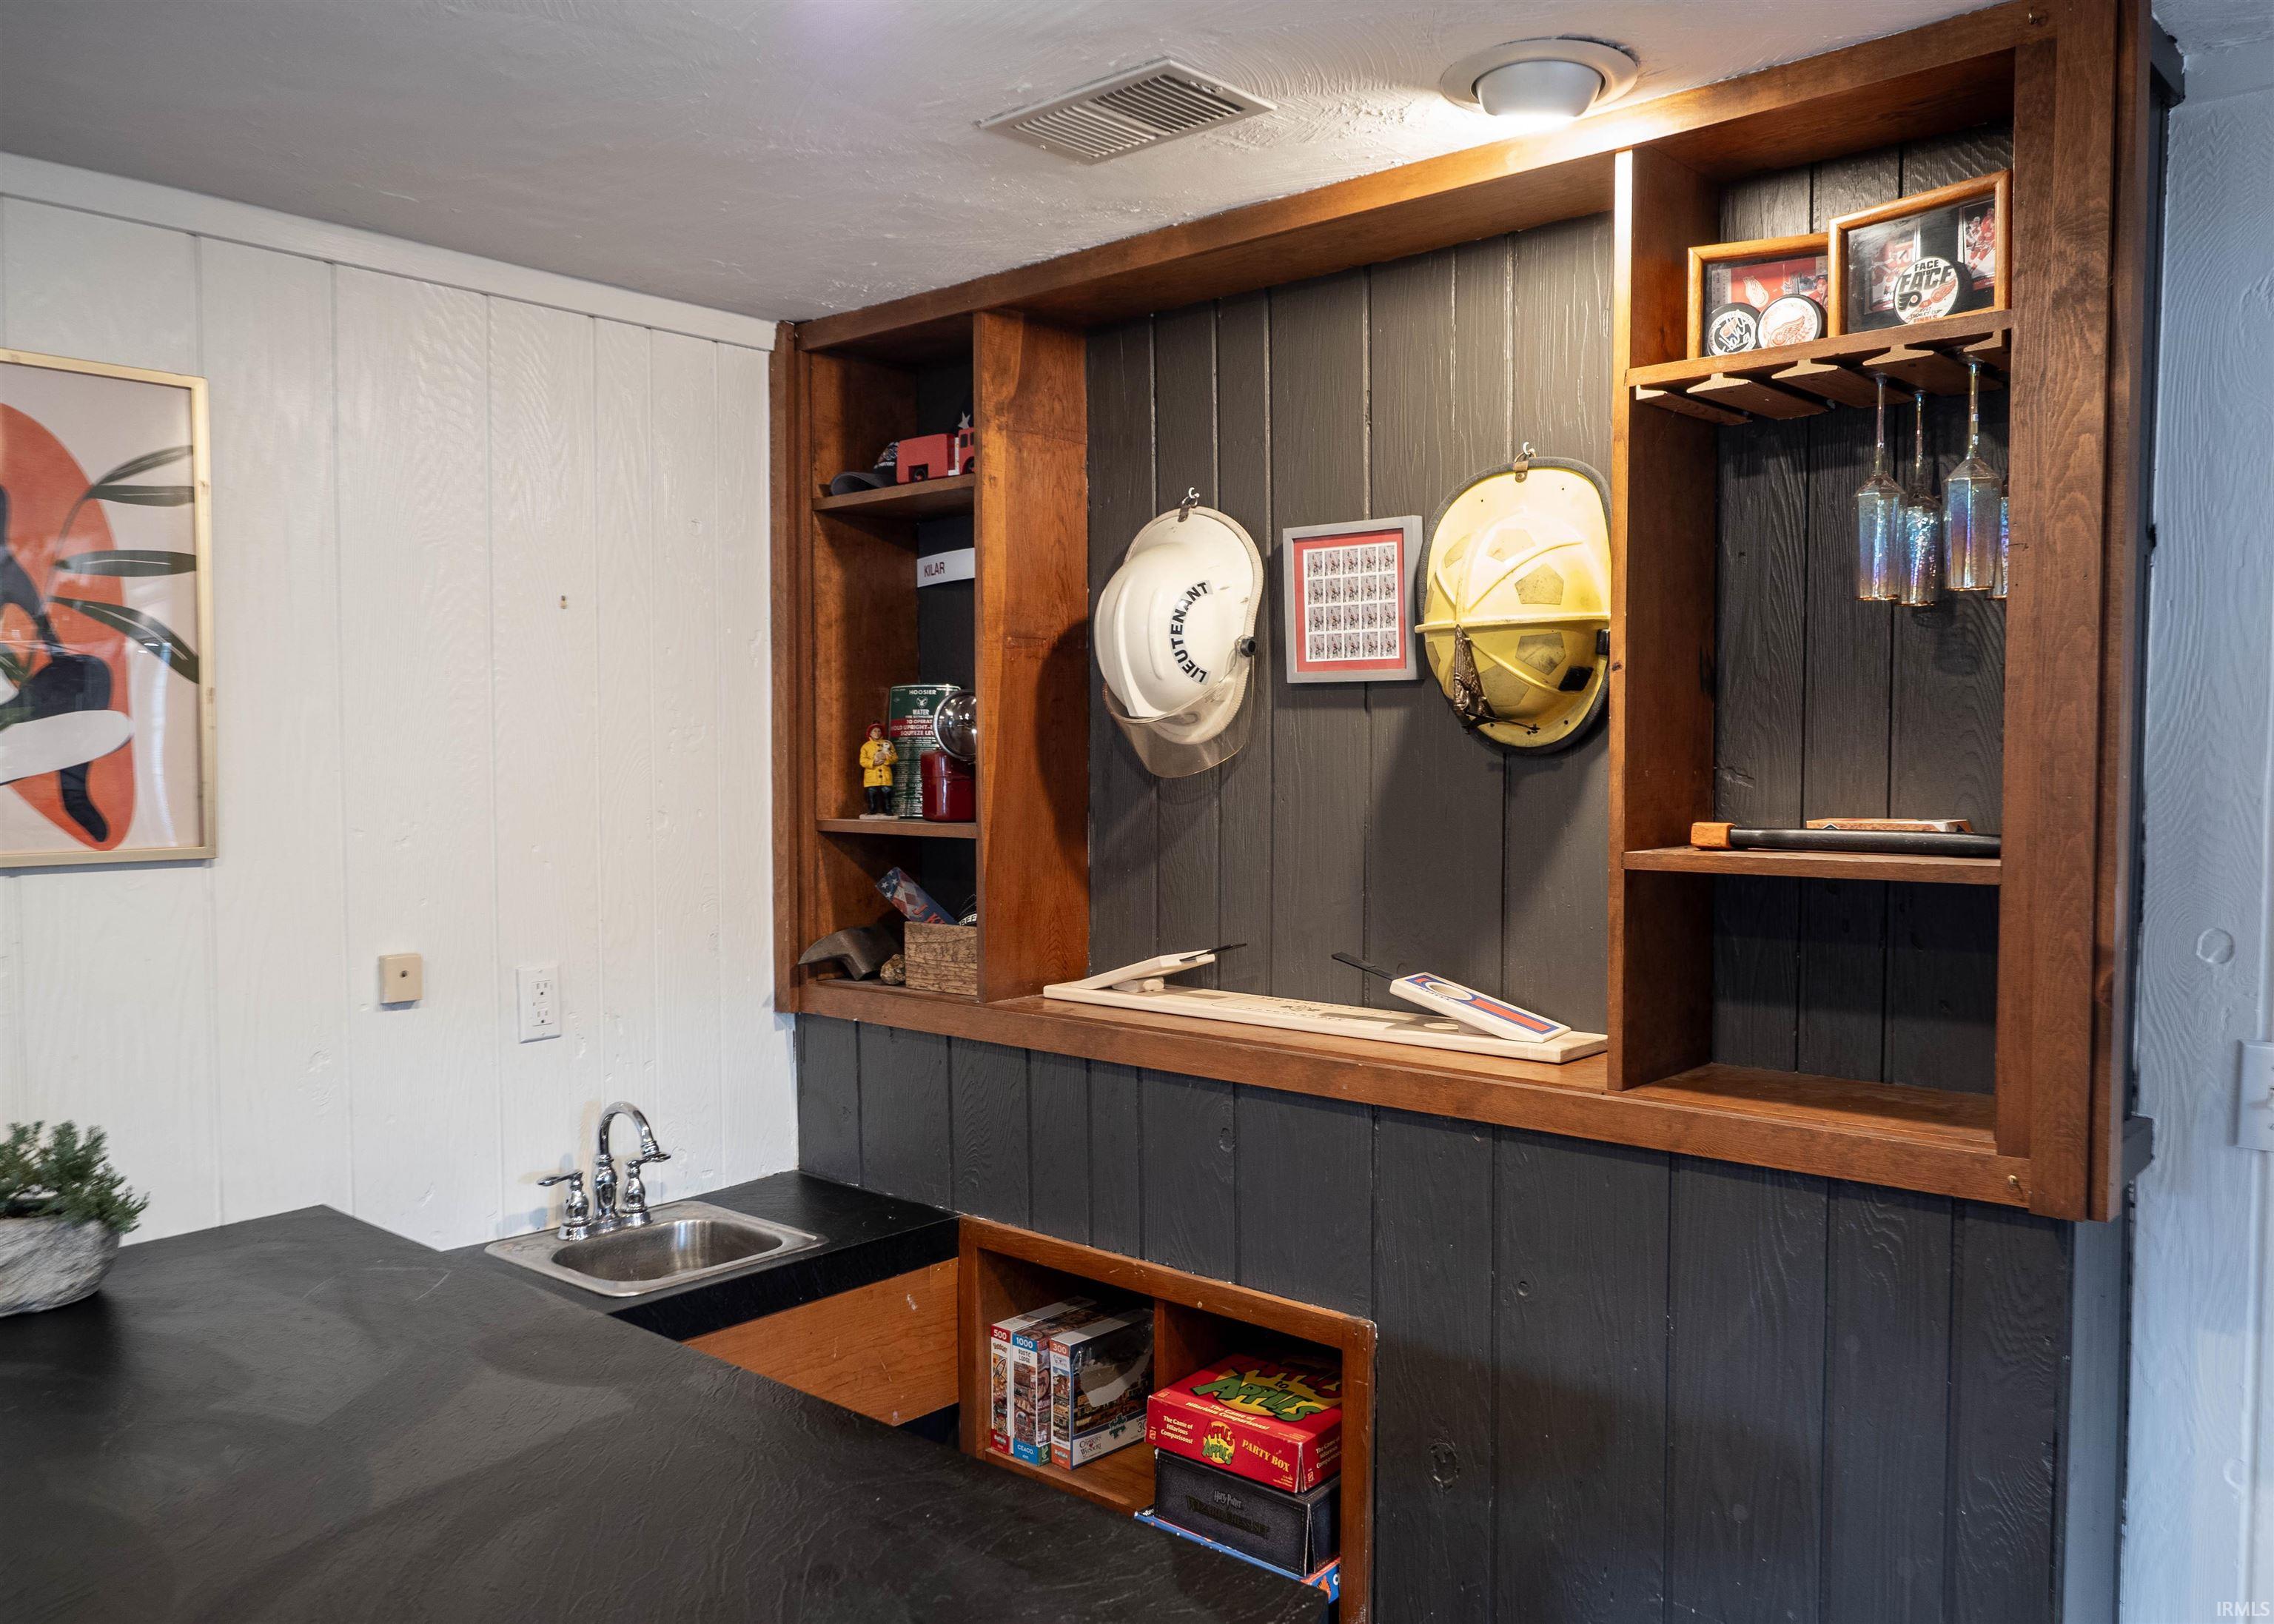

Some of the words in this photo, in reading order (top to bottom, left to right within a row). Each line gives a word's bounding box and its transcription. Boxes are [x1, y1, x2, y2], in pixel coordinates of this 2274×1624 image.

[1914, 260, 1939, 272] FACE
[1899, 266, 1954, 293] FACE
[924, 562, 945, 577] KILAR
[1170, 582, 1208, 683] LIEUTENANT
[993, 1329, 1007, 1341] 500
[1016, 1337, 1033, 1349] 1000
[1053, 1343, 1067, 1355] 300
[1190, 1373, 1323, 1422] APPLES
[1185, 1401, 1219, 1415] Hilarious
[1218, 1412, 1271, 1430] Comparisons!
[1210, 1404, 1224, 1412] The
[1224, 1408, 1246, 1418] Game
[1163, 1415, 1173, 1423] The
[1173, 1419, 1187, 1429] Game
[1166, 1423, 1188, 1435] Hilarious
[1161, 1429, 1193, 1444] Comparisons!
[1241, 1439, 1271, 1461] PARTY
[1271, 1455, 1290, 1472] BOX
